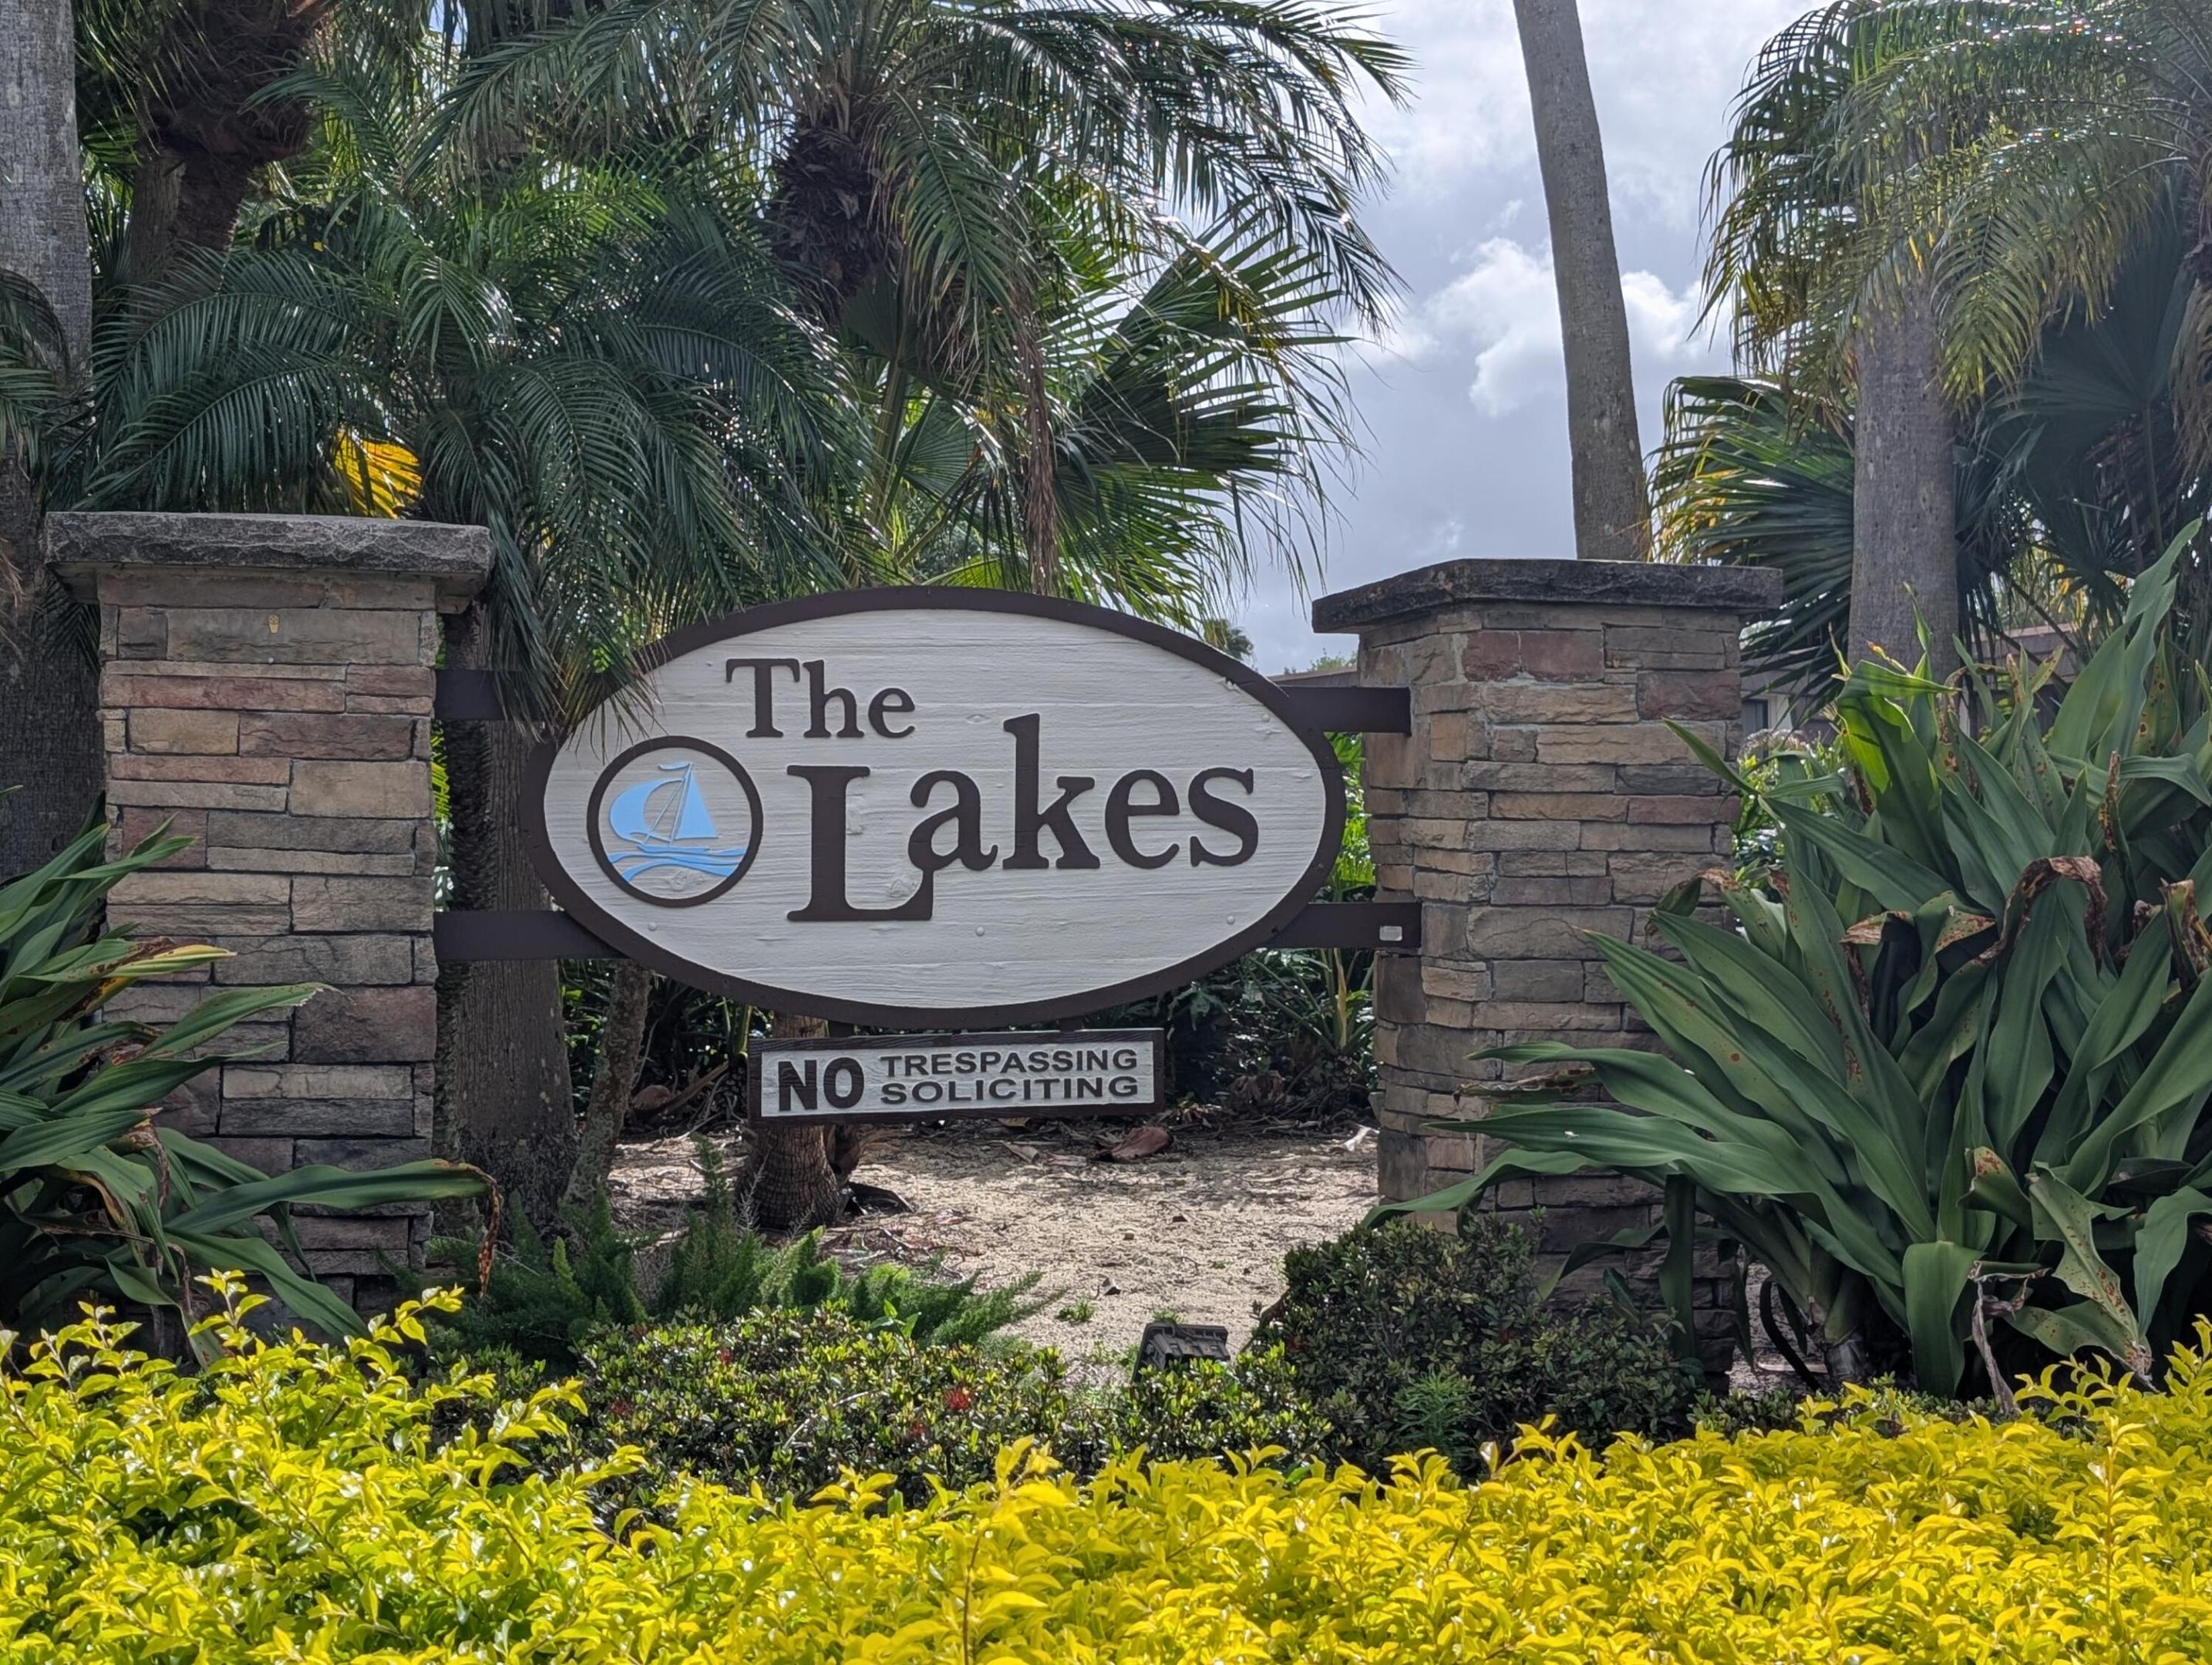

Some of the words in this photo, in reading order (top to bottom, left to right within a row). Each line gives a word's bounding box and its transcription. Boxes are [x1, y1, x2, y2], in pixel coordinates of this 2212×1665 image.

[725, 658, 916, 739] The
[786, 713, 1259, 923] Lakes
[777, 1057, 865, 1112] NO
[880, 1048, 1138, 1078] TRESPASSING
[880, 1075, 1138, 1105] SOLICITING
